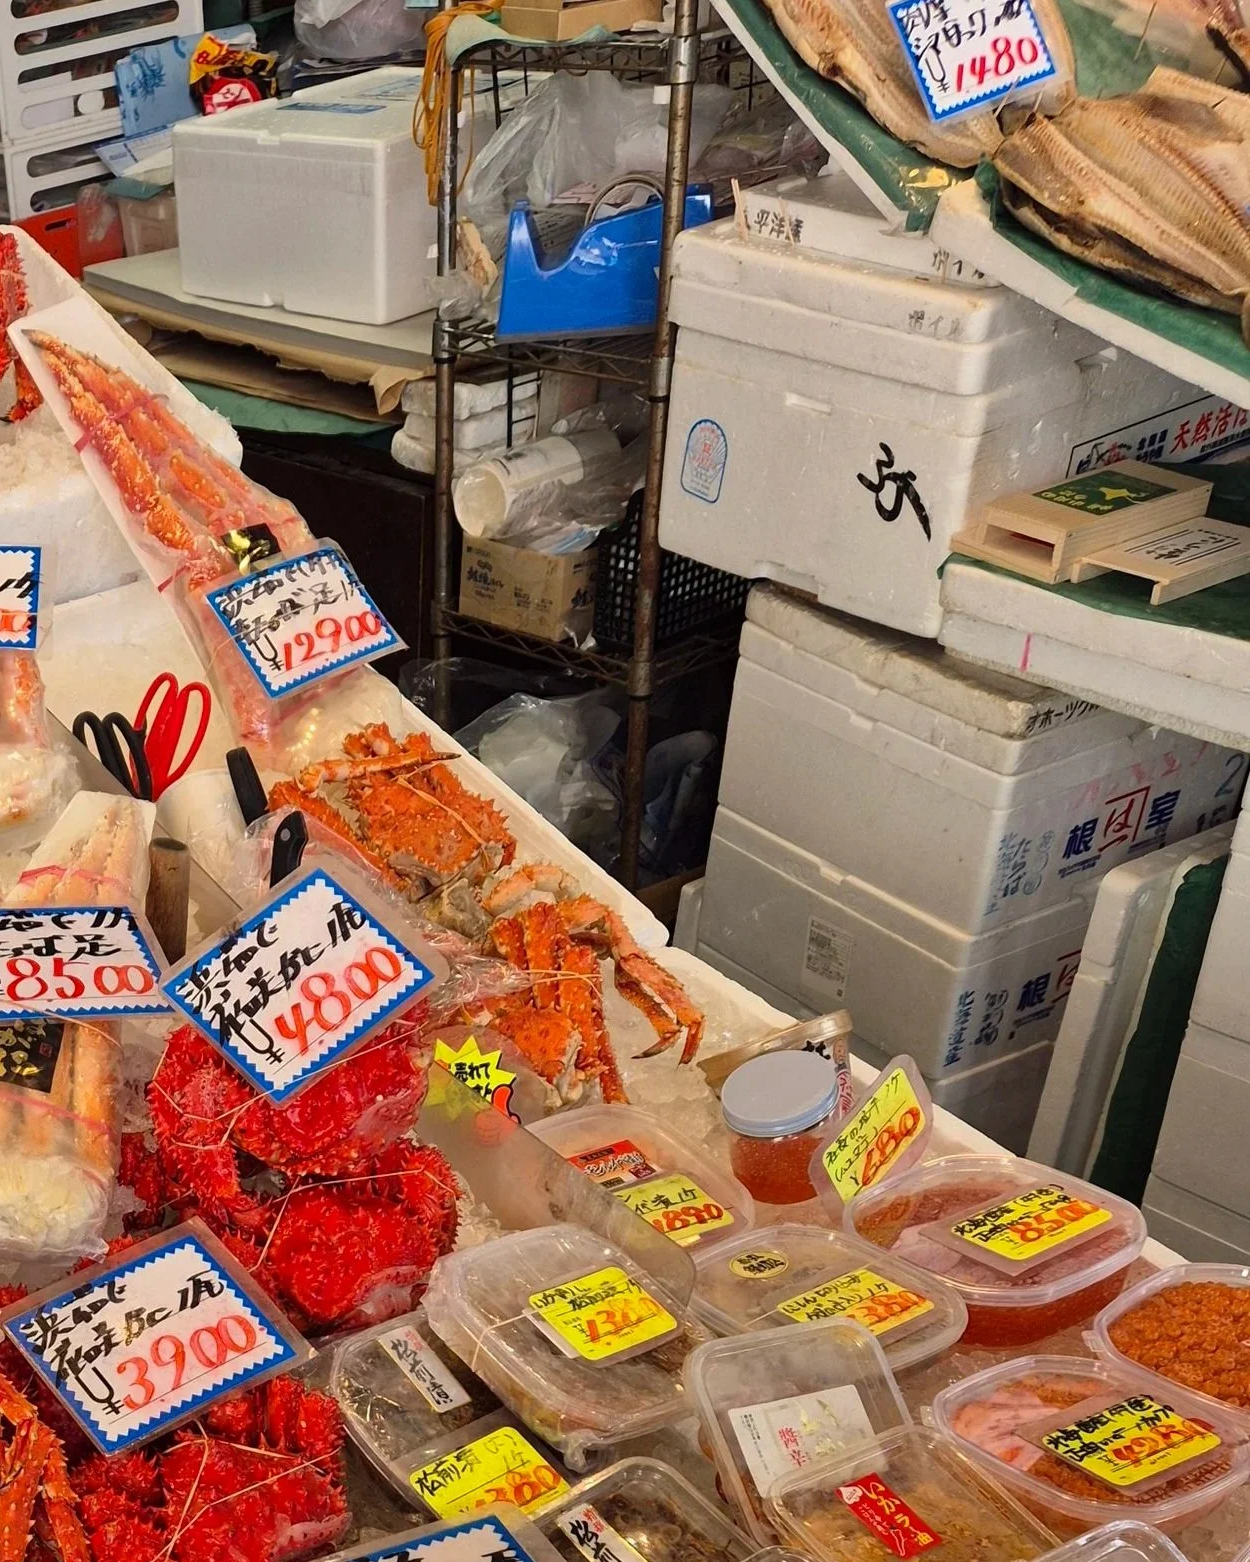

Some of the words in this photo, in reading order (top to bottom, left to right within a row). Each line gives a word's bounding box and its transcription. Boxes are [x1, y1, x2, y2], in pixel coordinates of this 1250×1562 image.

[924, 35, 1040, 96] ¥1480
[232, 943, 406, 1064] ¥4800
[72, 1312, 259, 1416] ¥3900
